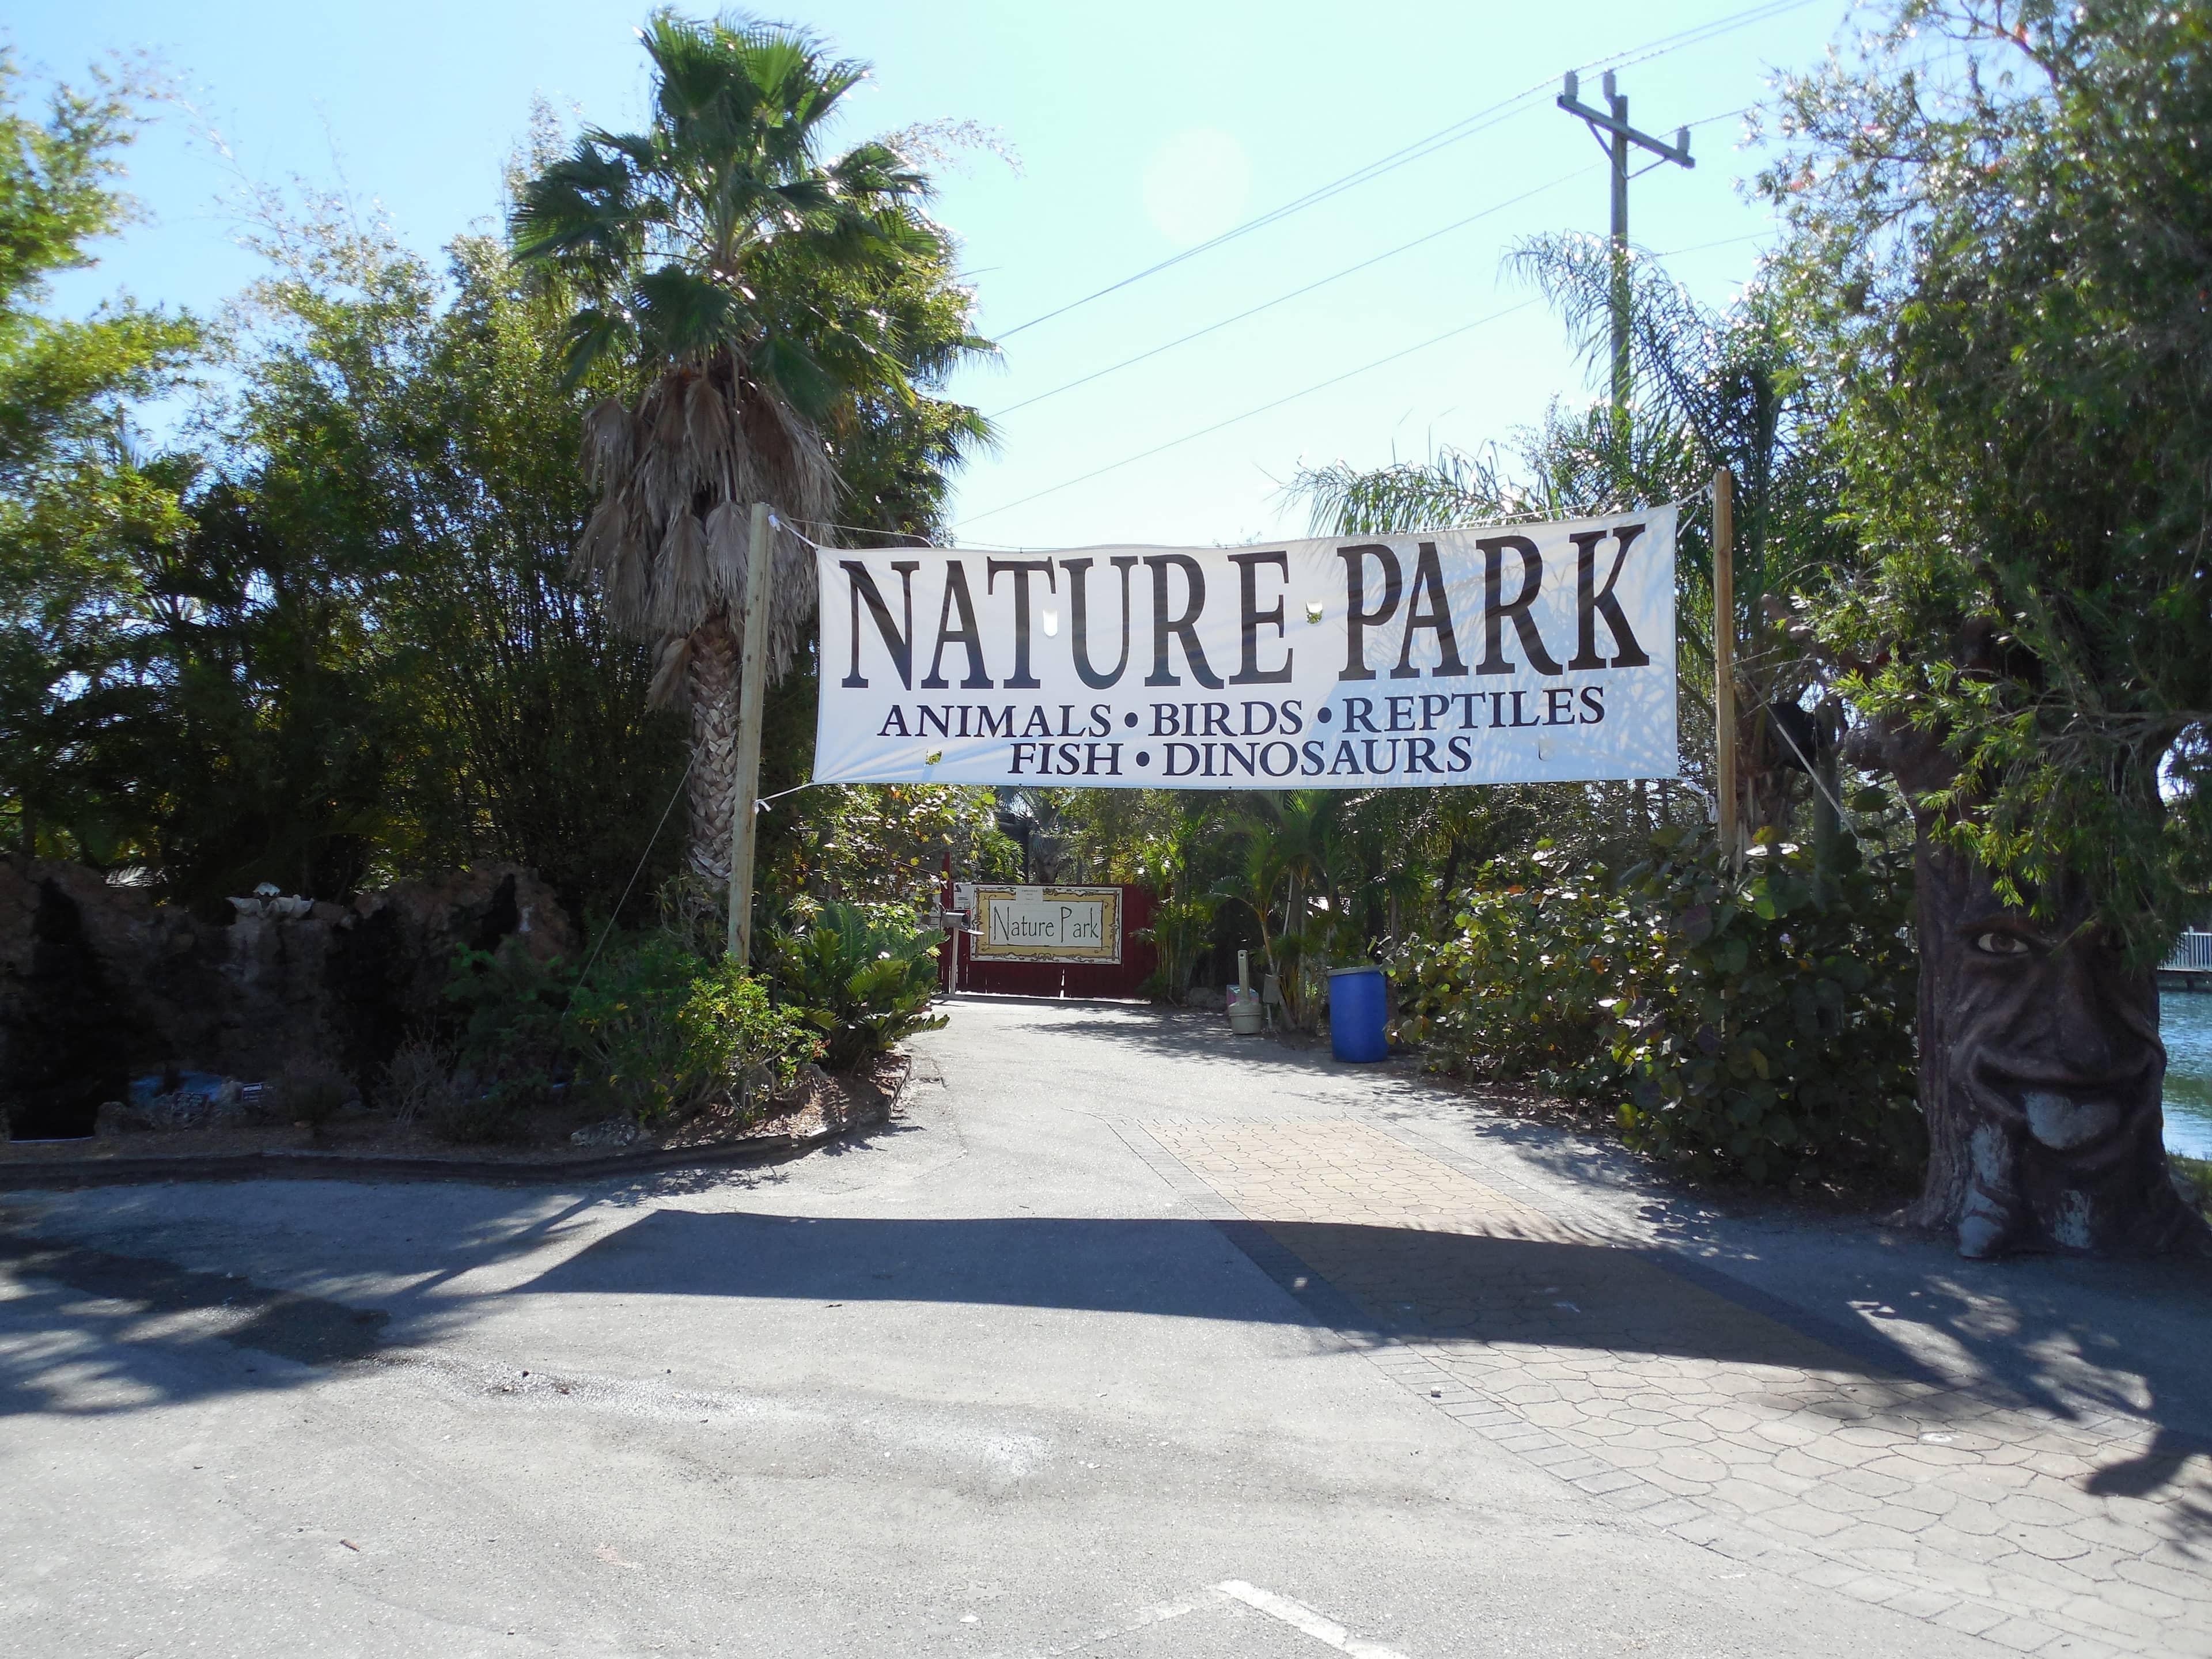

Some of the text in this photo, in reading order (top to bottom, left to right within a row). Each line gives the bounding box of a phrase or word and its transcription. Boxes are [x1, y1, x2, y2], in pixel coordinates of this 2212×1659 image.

[839, 523, 1650, 691] NATURE PARK
[876, 685, 1605, 738] ANIMALS BIRDS REPTILES
[1007, 736, 1473, 777] FISH DINOSAURS
[993, 906, 1099, 943] Nature Park
